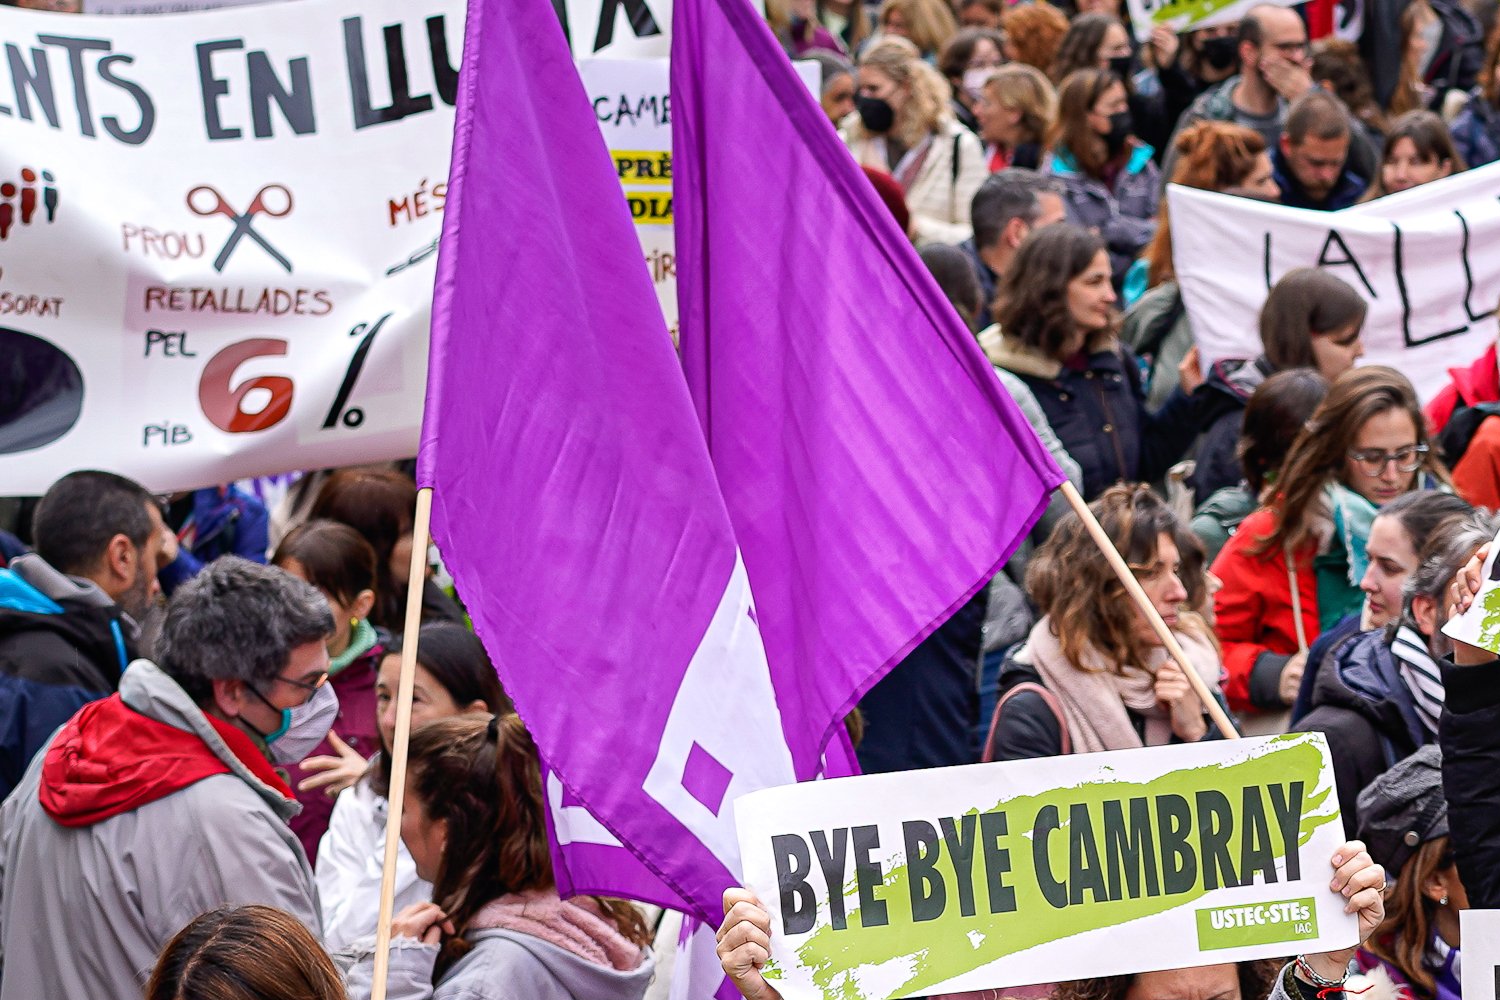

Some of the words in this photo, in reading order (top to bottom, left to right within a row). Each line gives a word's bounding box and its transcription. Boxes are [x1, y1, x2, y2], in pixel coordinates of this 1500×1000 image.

[0, 34, 155, 144] NTS
[197, 39, 315, 139] EN
[388, 180, 447, 226] MÉS
[122, 222, 205, 259] PROU
[0, 291, 64, 319] SORAT
[145, 287, 333, 315] RETALLADES
[144, 330, 196, 357] PEL
[771, 823, 889, 935] BYE
[901, 811, 1016, 922] BYE
[1032, 781, 1304, 909] CAMBRAY
[1294, 922, 1312, 934] IAC
